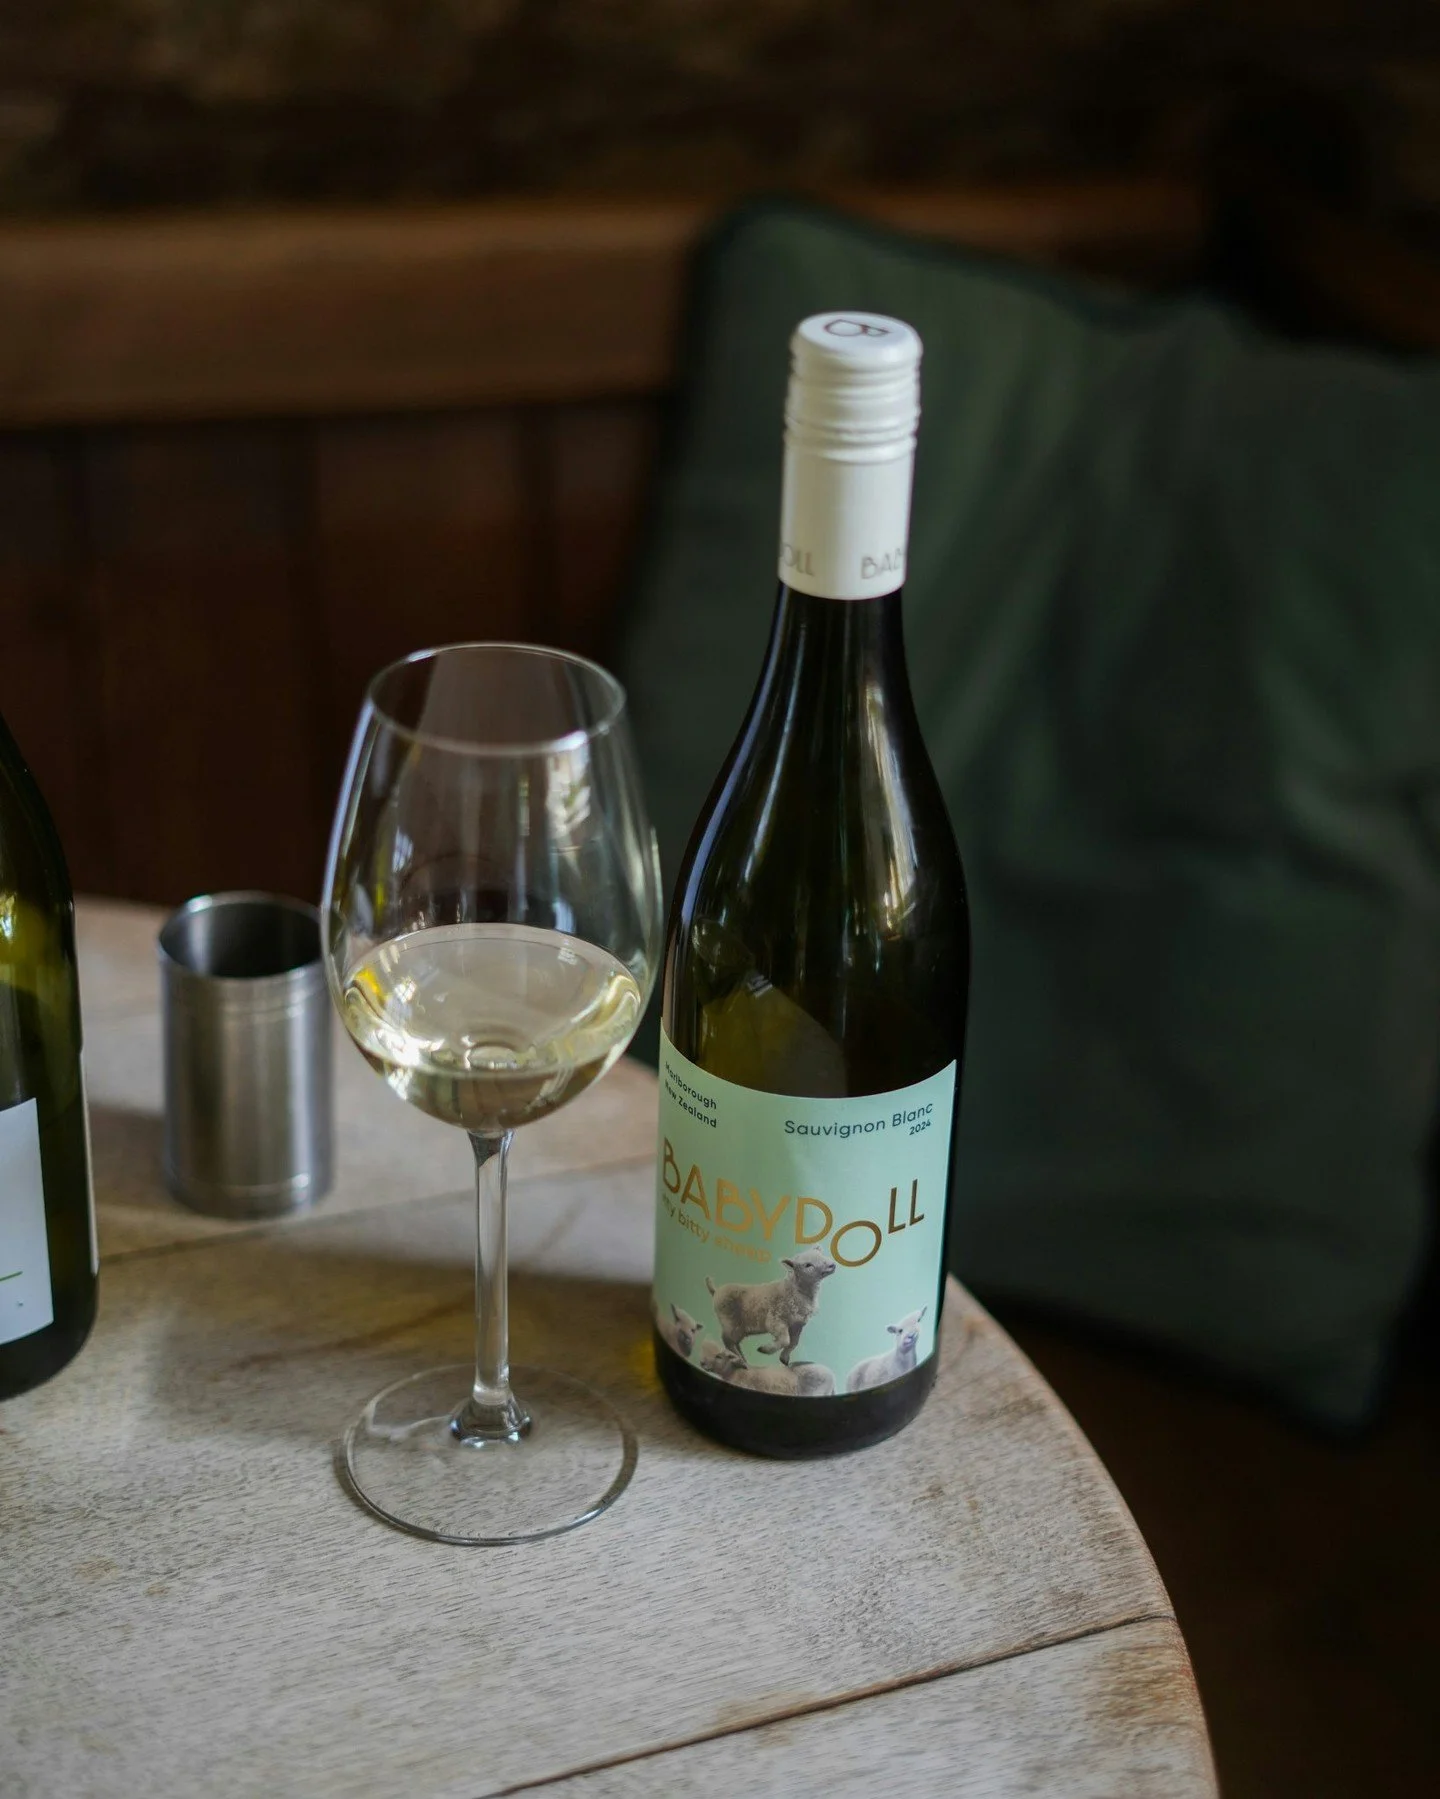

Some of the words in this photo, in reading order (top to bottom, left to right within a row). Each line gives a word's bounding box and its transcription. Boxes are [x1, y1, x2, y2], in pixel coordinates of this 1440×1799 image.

[665, 1061, 717, 1110] Marlborough
[678, 1096, 717, 1128] Zealand
[784, 1119, 886, 1139] Sauvignon
[892, 1103, 934, 1128] Blanc
[909, 1119, 932, 1136] 2024
[662, 1136, 925, 1268] BABYDOLL
[678, 1208, 710, 1243] bitty
